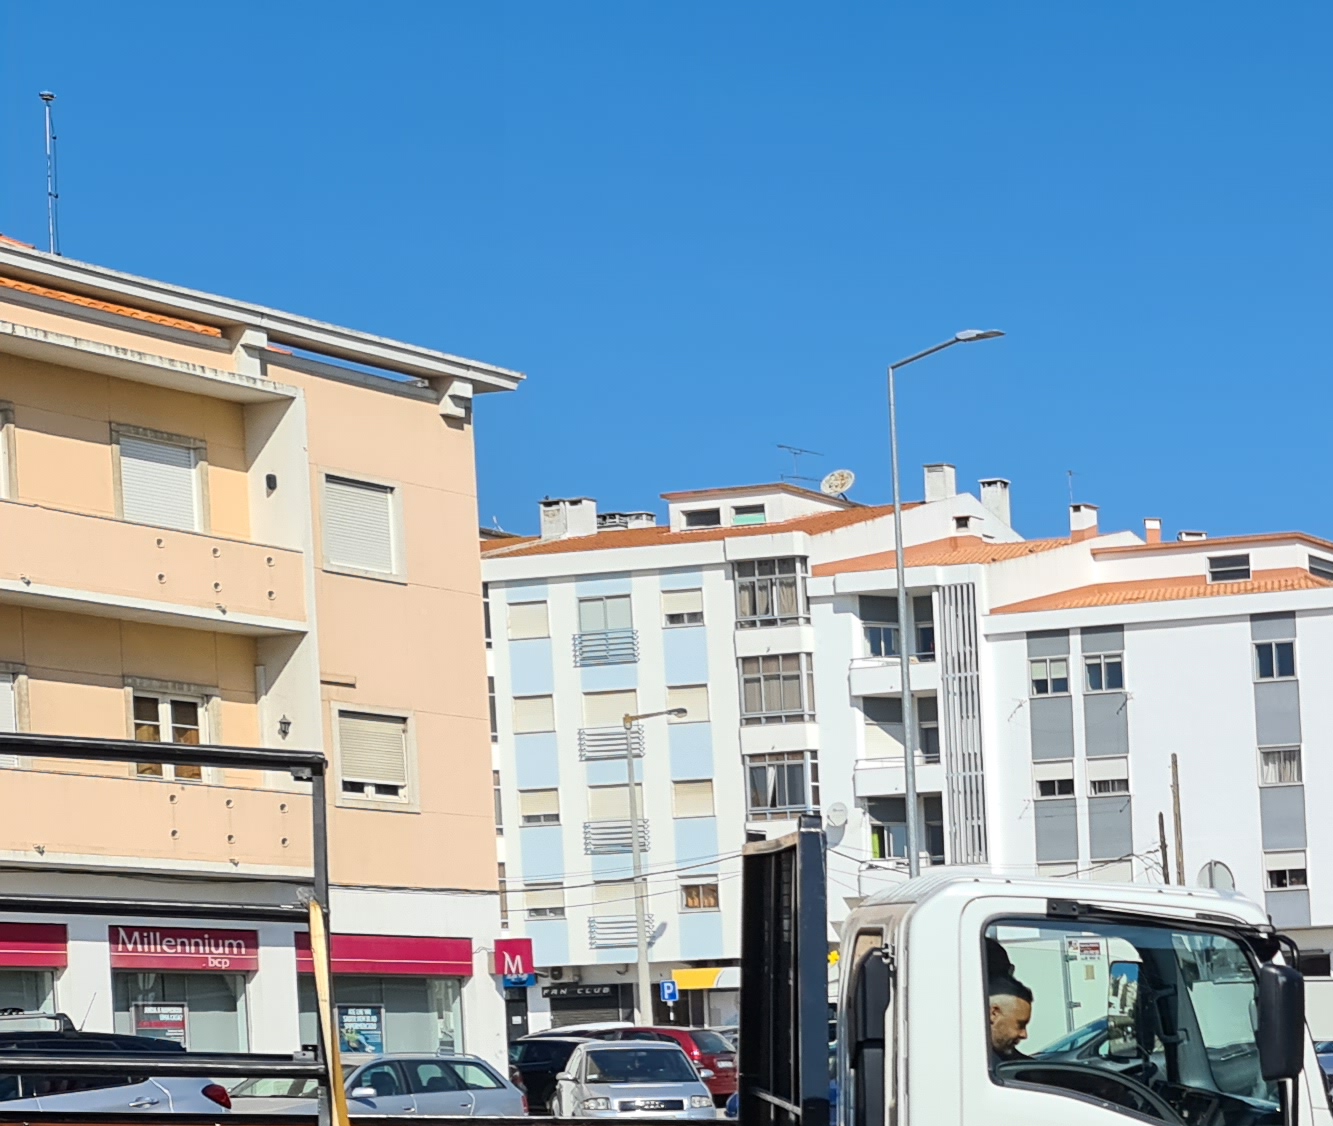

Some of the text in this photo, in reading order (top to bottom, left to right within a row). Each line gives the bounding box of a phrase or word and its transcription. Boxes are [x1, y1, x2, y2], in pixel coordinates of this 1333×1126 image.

[118, 927, 246, 955] Millennium
[502, 951, 523, 974] M
[543, 988, 567, 996] FAN
[664, 983, 673, 999] P
